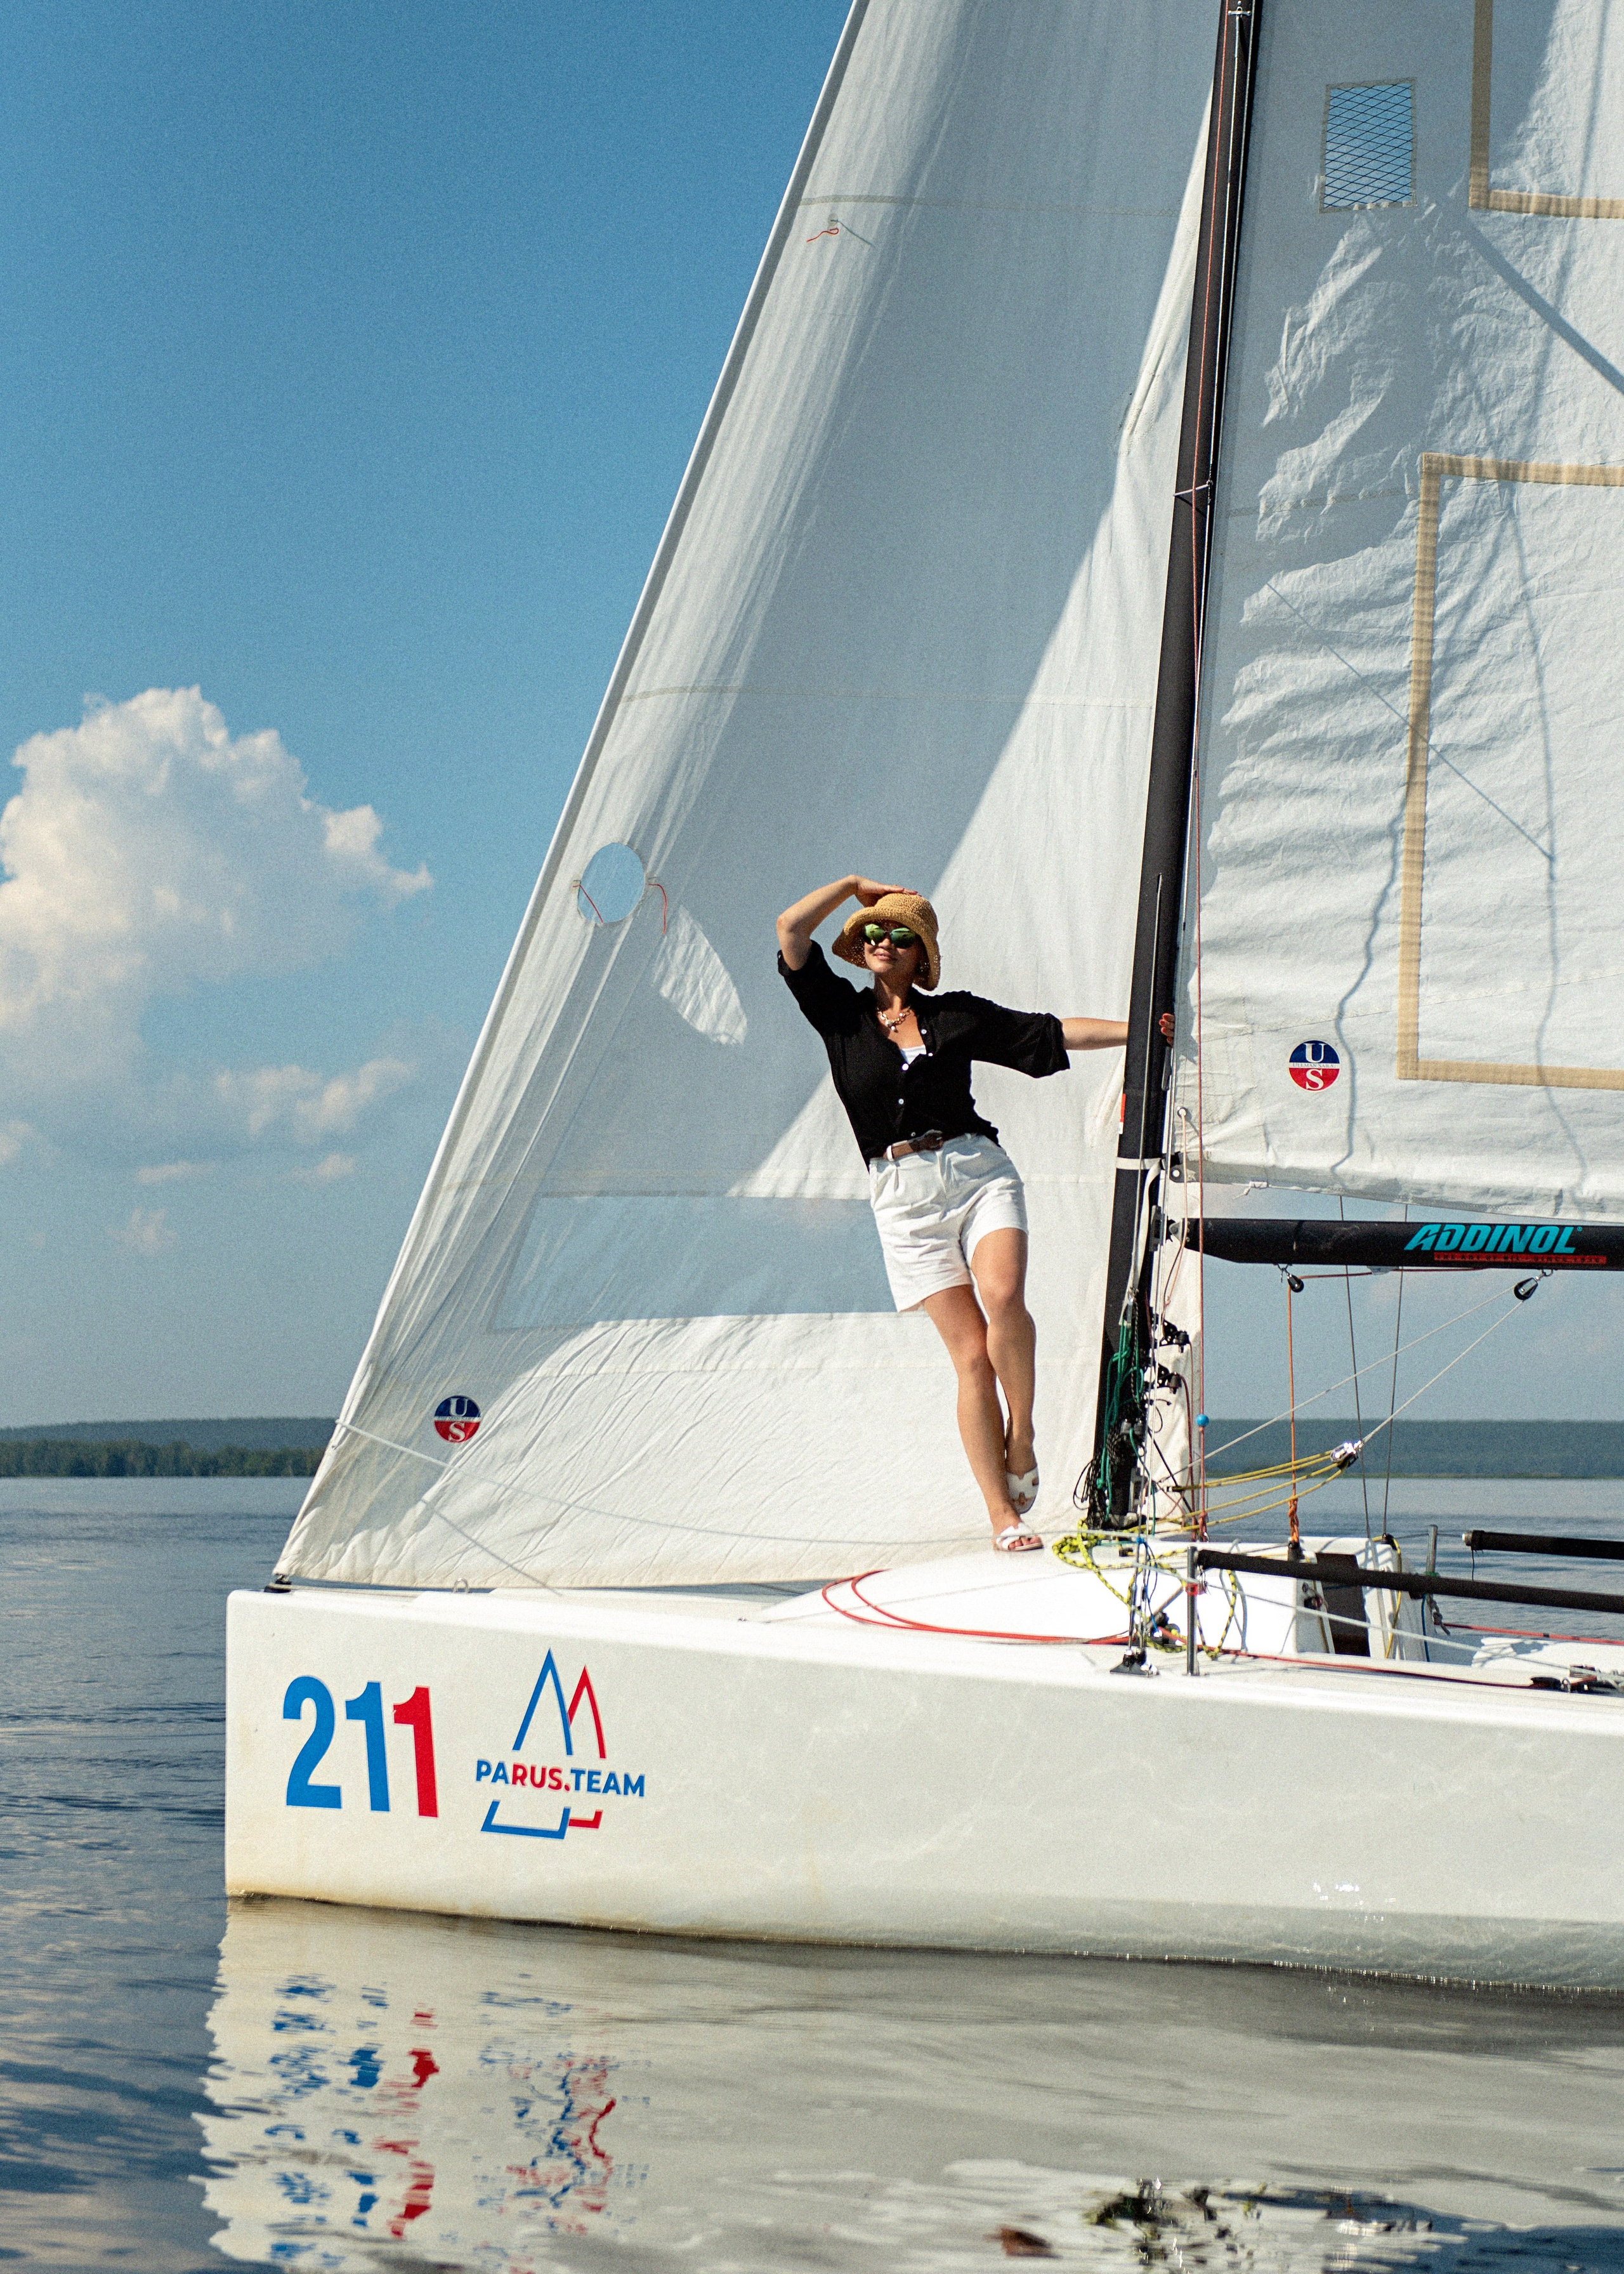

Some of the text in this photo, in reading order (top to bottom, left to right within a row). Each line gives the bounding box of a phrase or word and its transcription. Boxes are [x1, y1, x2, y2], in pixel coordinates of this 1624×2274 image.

[1303, 1042, 1327, 1063] U
[1306, 1068, 1324, 1090] S
[1403, 1223, 1576, 1254] ADDINOL
[449, 1398, 469, 1417] U
[448, 1421, 466, 1442] S
[282, 1674, 439, 1818] 211
[475, 1758, 645, 1798] PARUS.TEAM
